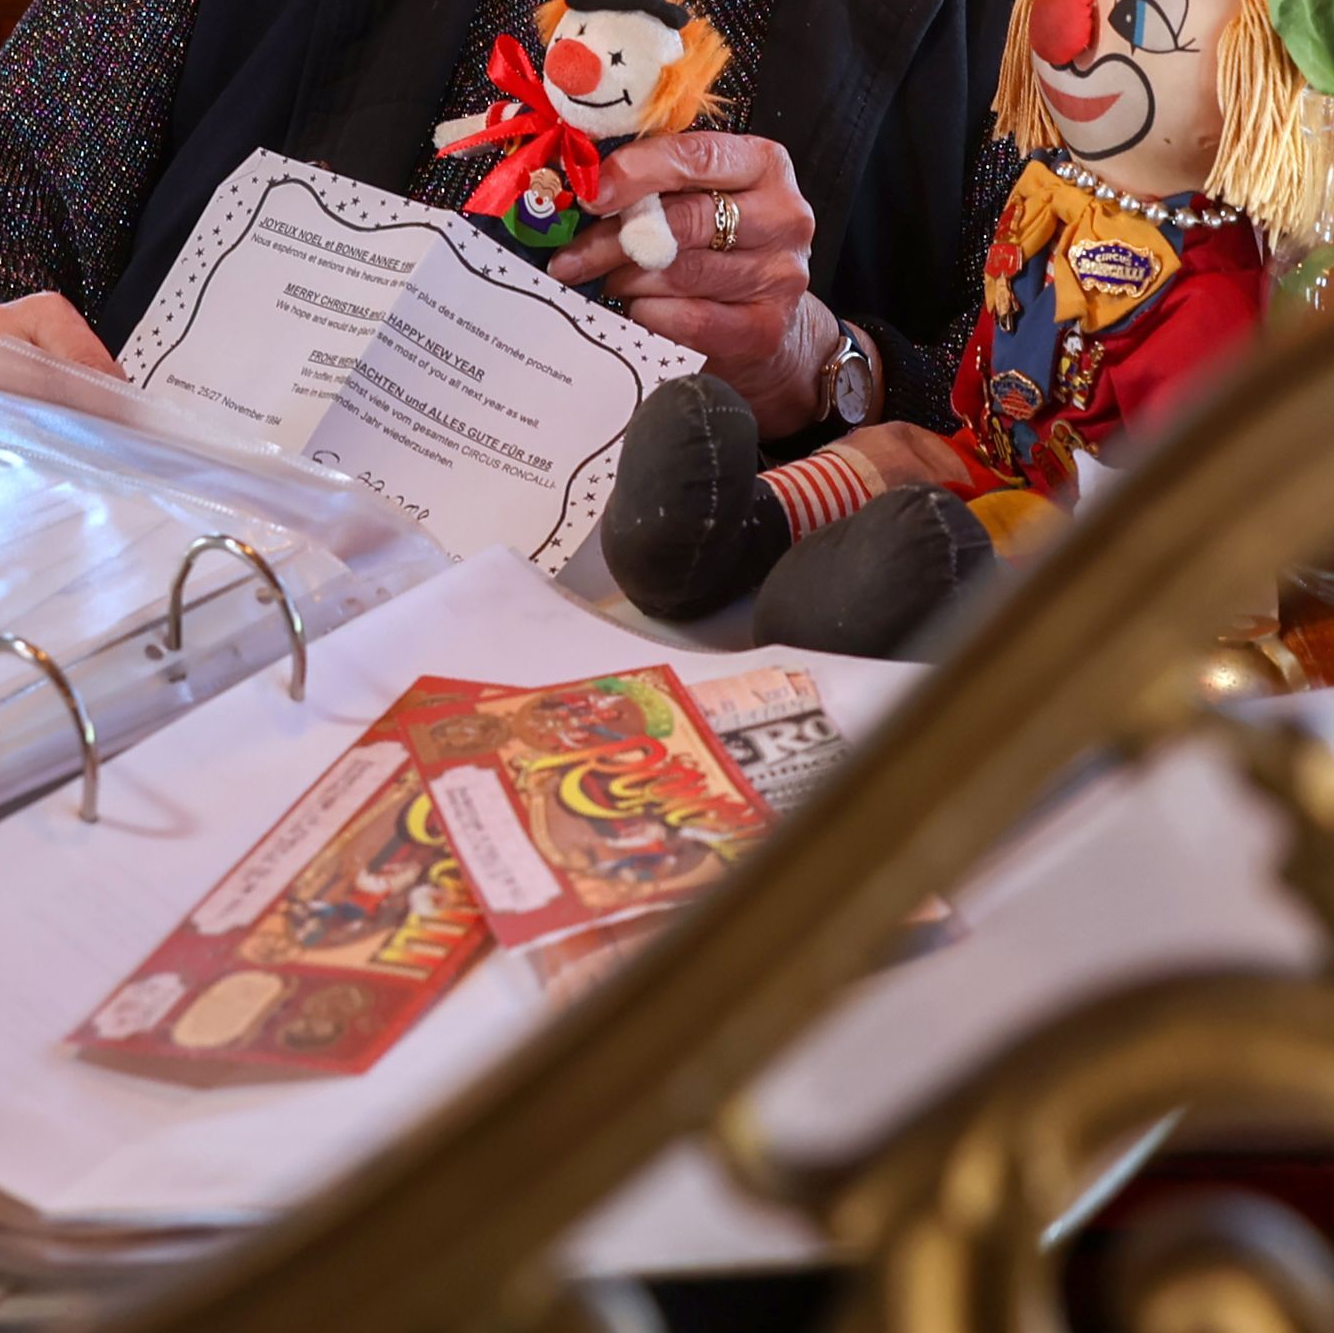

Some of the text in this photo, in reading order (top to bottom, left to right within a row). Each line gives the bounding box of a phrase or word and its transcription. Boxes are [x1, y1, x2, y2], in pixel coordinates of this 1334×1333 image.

[259, 217, 298, 236] JOYEUX
[298, 227, 323, 247] NOEL
[325, 240, 335, 249] et
[335, 241, 370, 261] BONNE
[369, 253, 400, 270] ANNEE
[251, 233, 271, 247] Nous
[272, 240, 307, 261] espérons
[307, 254, 317, 264] et
[318, 258, 345, 274] serions
[418, 292, 437, 309] plus
[438, 304, 455, 320] des
[456, 318, 491, 342] artistes
[490, 336, 526, 361] l'année
[525, 357, 574, 386] prochaine.
[284, 283, 321, 303] MERRY
[320, 295, 370, 318] CHRISTMAS
[387, 313, 426, 342] HAPPY
[424, 340, 453, 361] NEW
[454, 355, 485, 381] YEAR
[276, 299, 289, 311] We
[290, 306, 312, 320] hope
[312, 314, 327, 325] and
[376, 331, 394, 347] see
[394, 343, 417, 364] most
[418, 358, 430, 370] of
[428, 366, 448, 383] you
[448, 376, 461, 390] all
[460, 385, 483, 402] next
[482, 393, 505, 413] year
[505, 407, 518, 419] as
[221, 396, 265, 421] November
[360, 411, 383, 429] Jahr
[368, 393, 390, 411] viele
[391, 407, 412, 426] vom
[412, 420, 460, 451] gesamten
[461, 444, 502, 469] CIRCUS
[405, 393, 429, 412] und
[428, 407, 466, 433] ALLES
[467, 427, 500, 450] GUTE
[501, 442, 525, 462] FÜR
[528, 453, 555, 470] 1995
